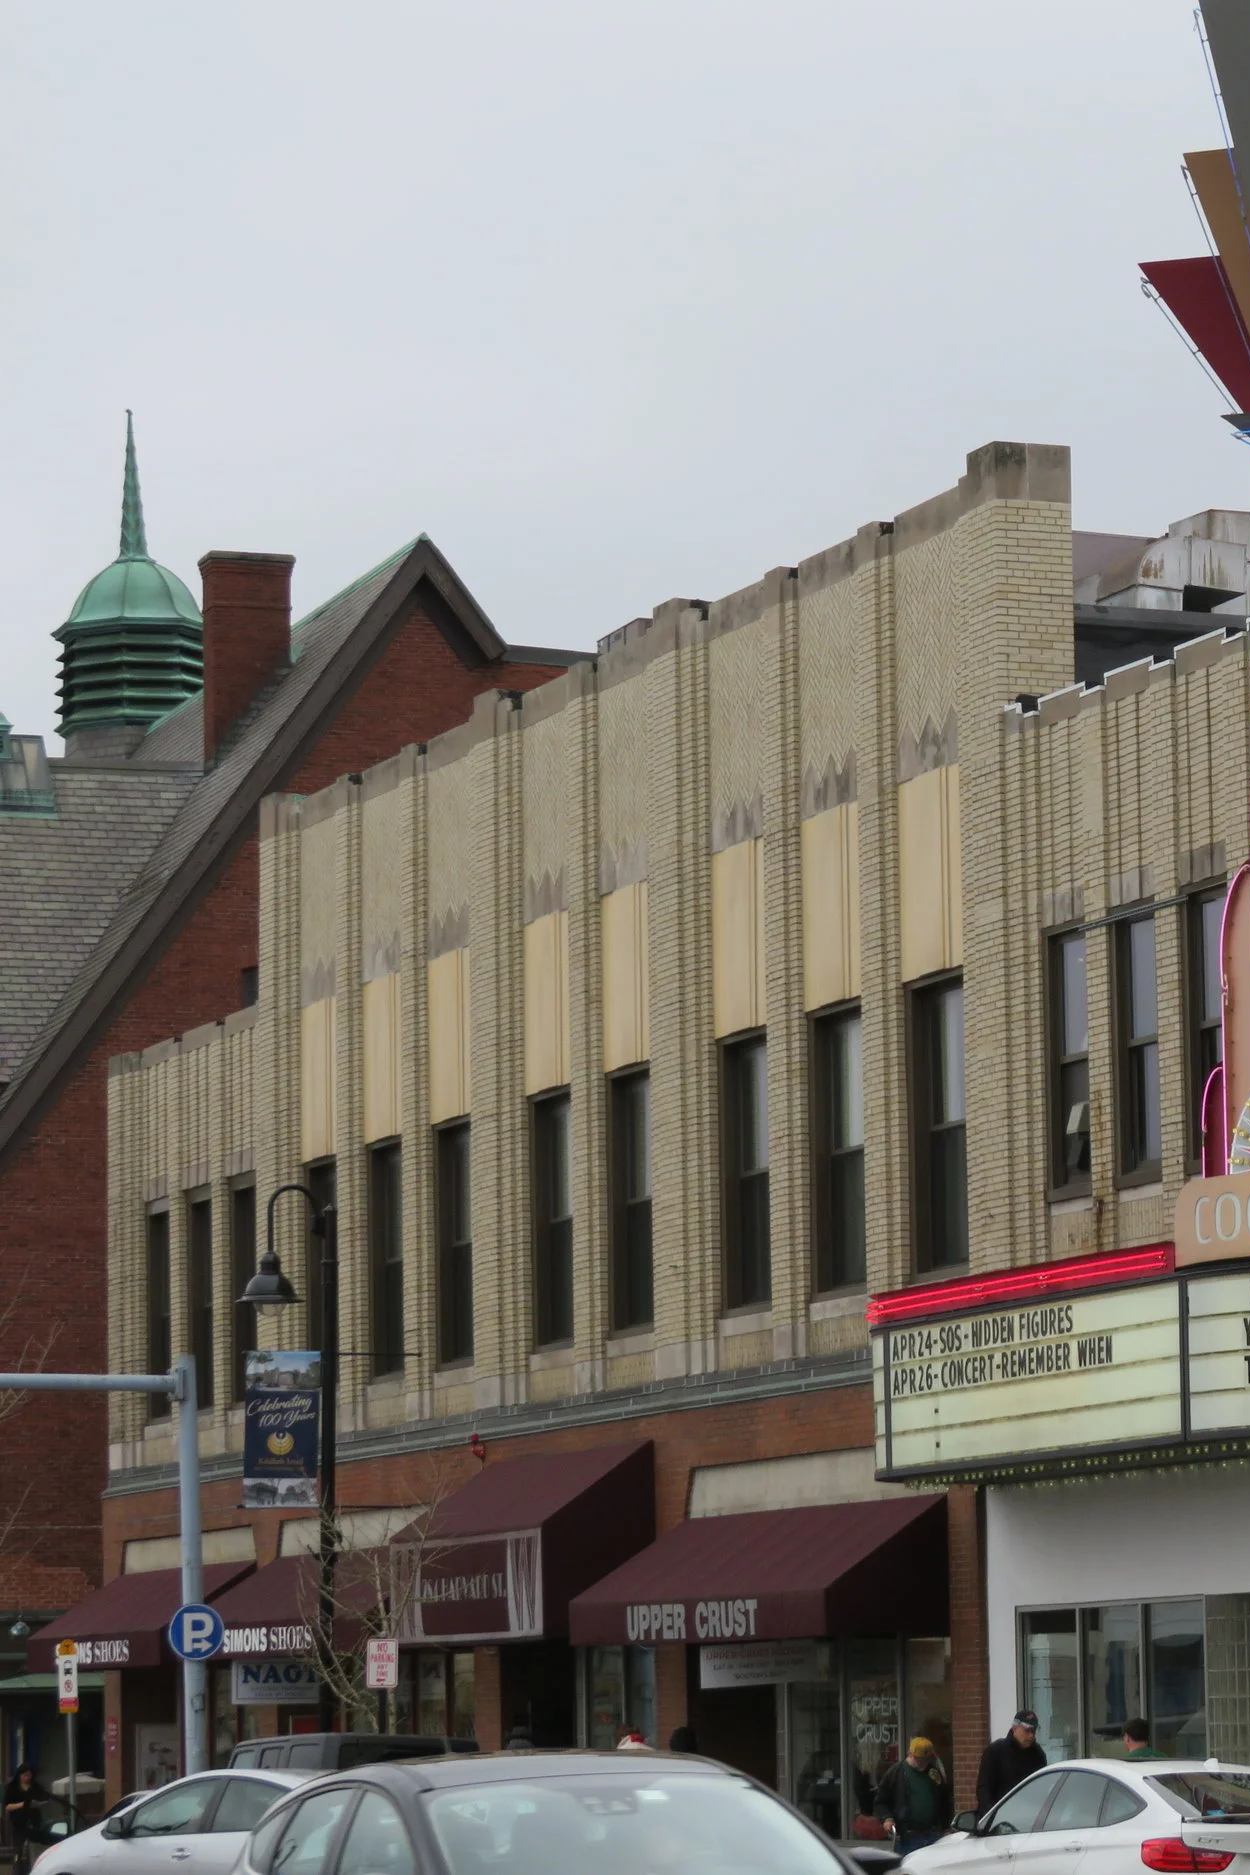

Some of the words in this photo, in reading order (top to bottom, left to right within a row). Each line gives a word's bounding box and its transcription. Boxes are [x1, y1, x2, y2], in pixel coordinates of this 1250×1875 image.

[1019, 1305, 1074, 1341] FIGURES
[1077, 1335, 1113, 1367] WHEN
[247, 1394, 313, 1416] Celebrating
[259, 1412, 281, 1428] 100
[283, 1410, 316, 1428] Years
[627, 1603, 686, 1641] UPPER
[695, 1598, 757, 1639] CRUST
[183, 1612, 214, 1653] P
[223, 1627, 267, 1653] SIMONS
[269, 1625, 312, 1650] SHOES
[93, 1640, 130, 1663] SHOES
[371, 1653, 395, 1663] PARKING
[376, 1643, 388, 1652] NO
[855, 1696, 898, 1717] UPPER
[855, 1723, 898, 1745] CRUST
